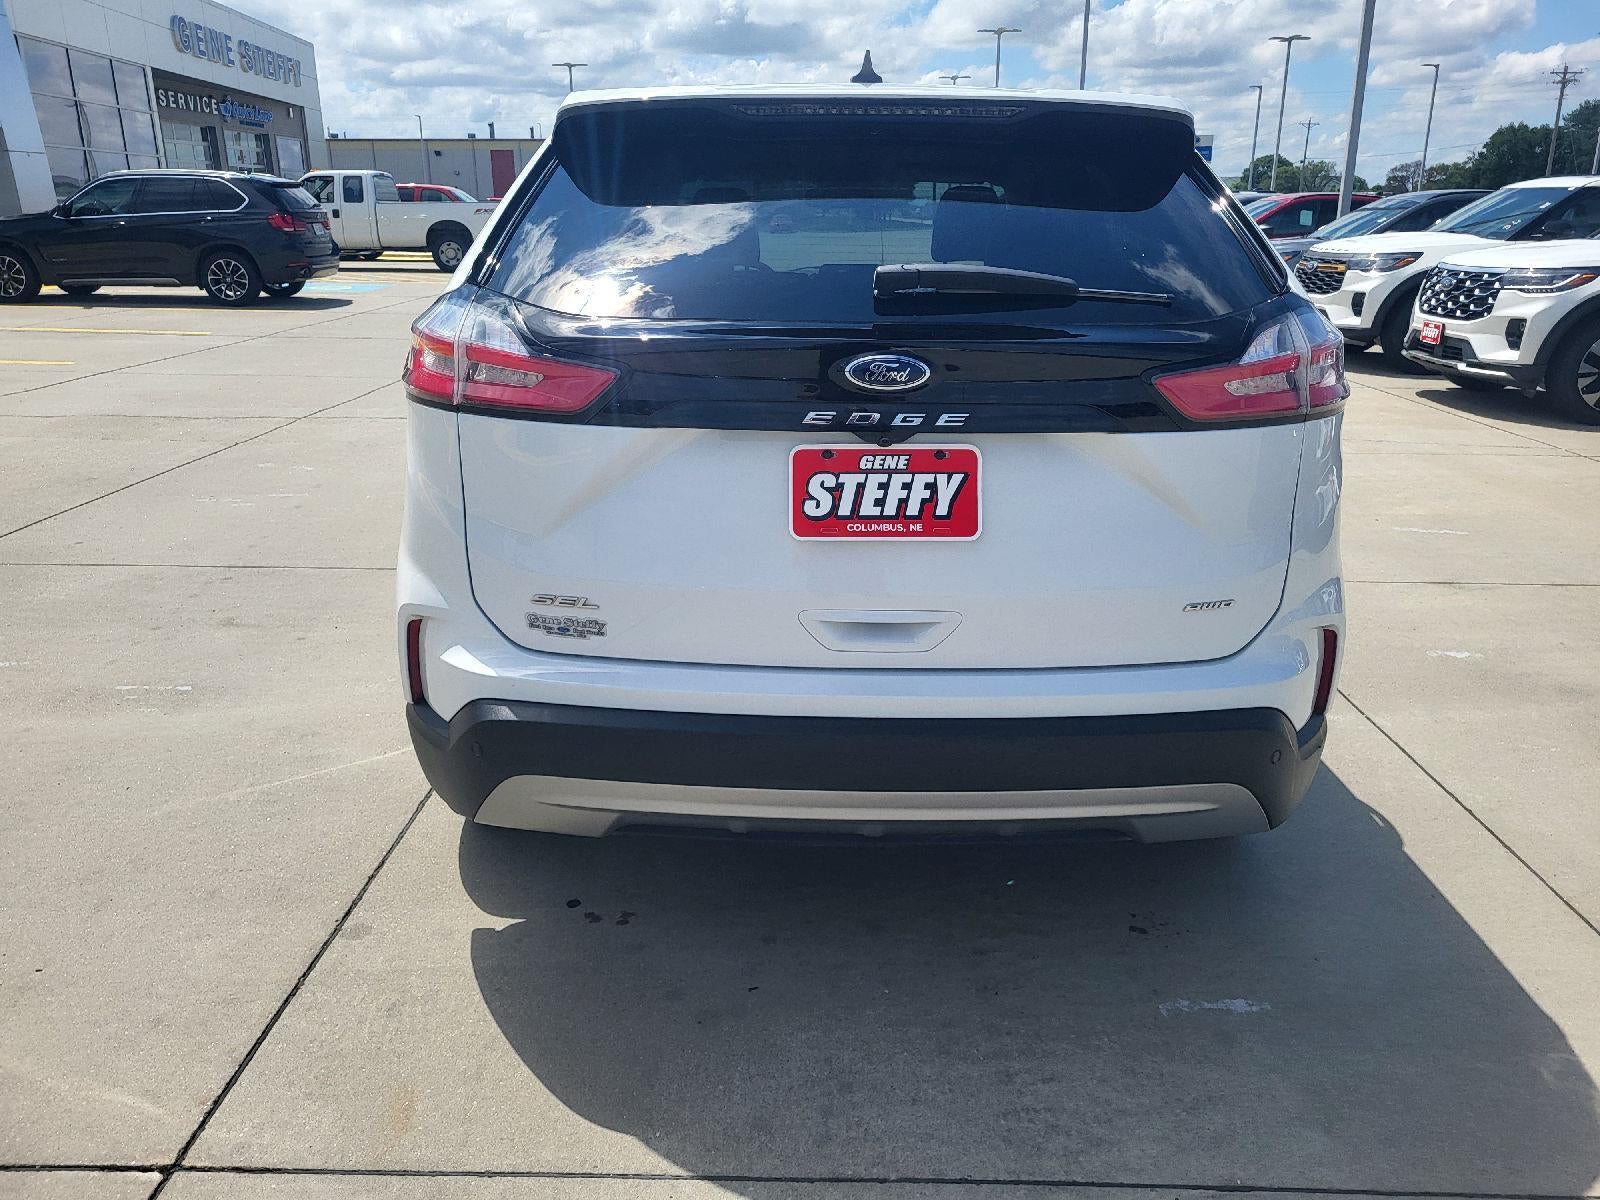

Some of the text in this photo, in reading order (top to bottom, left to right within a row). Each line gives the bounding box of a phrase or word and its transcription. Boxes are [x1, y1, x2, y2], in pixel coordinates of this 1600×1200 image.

[170, 15, 301, 87] GENE STEFFY
[158, 90, 219, 115] SERVICE
[864, 362, 911, 381] Ford
[801, 411, 970, 426] EDGE
[858, 454, 911, 470] GENE
[802, 471, 968, 520] STEFFY
[846, 523, 923, 533] COLUMBUS, NE
[530, 593, 600, 609] SEL
[527, 613, 561, 625] Gene
[563, 617, 606, 632] Steffy
